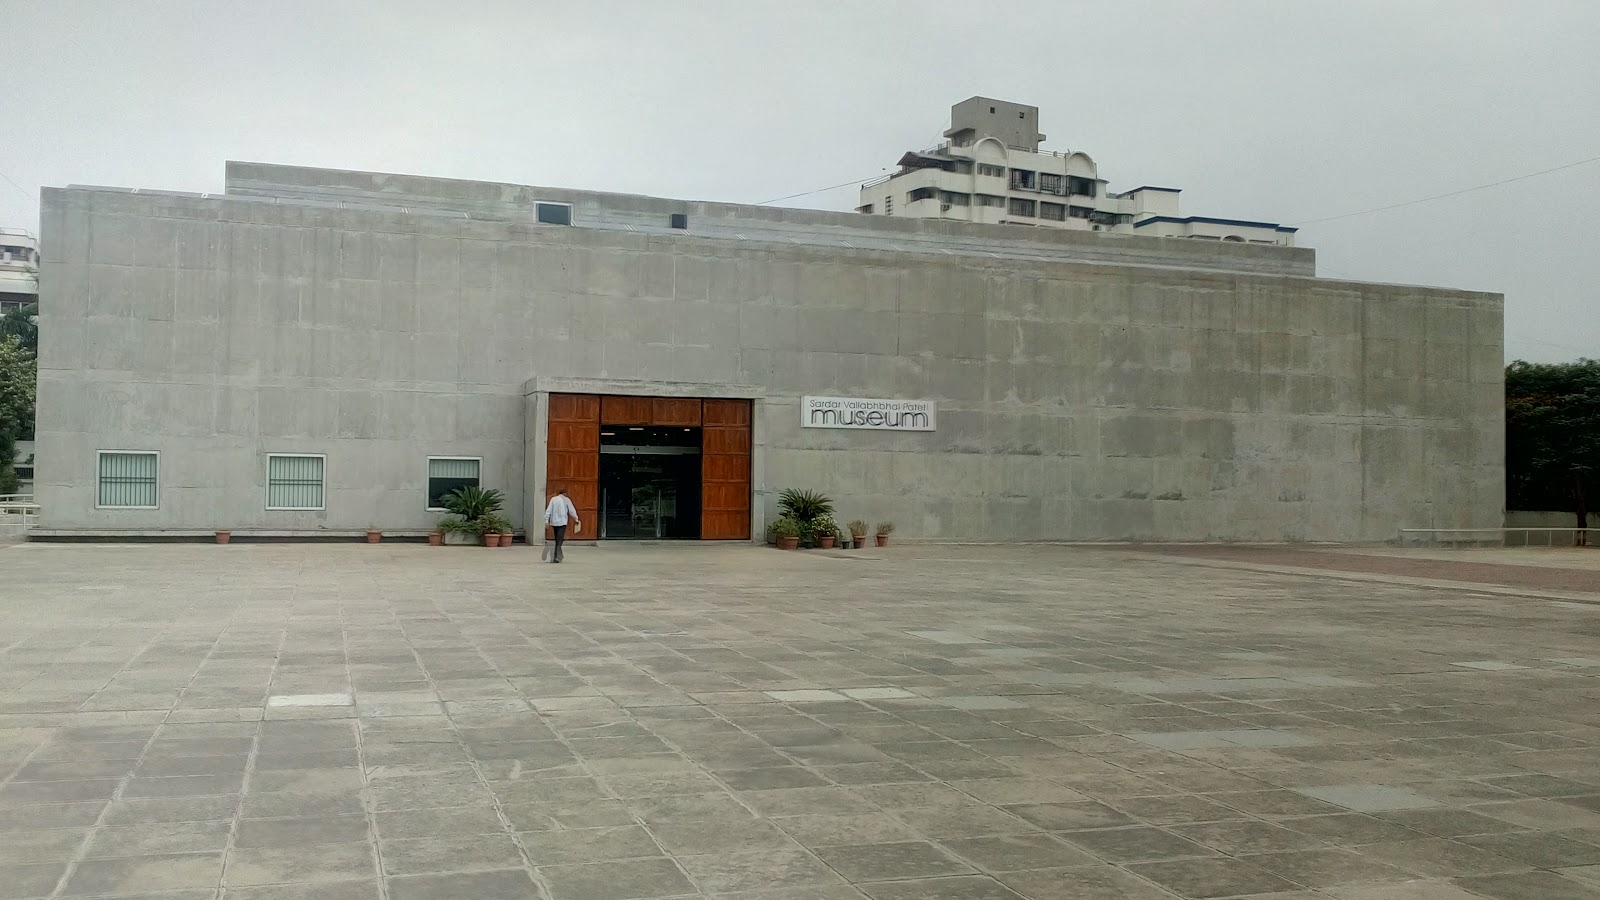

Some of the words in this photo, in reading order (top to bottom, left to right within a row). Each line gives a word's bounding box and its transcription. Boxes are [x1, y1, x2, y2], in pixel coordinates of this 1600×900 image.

[809, 399, 841, 408] Sardar
[843, 400, 901, 411] Vallabhbhai
[811, 409, 929, 428] museum
